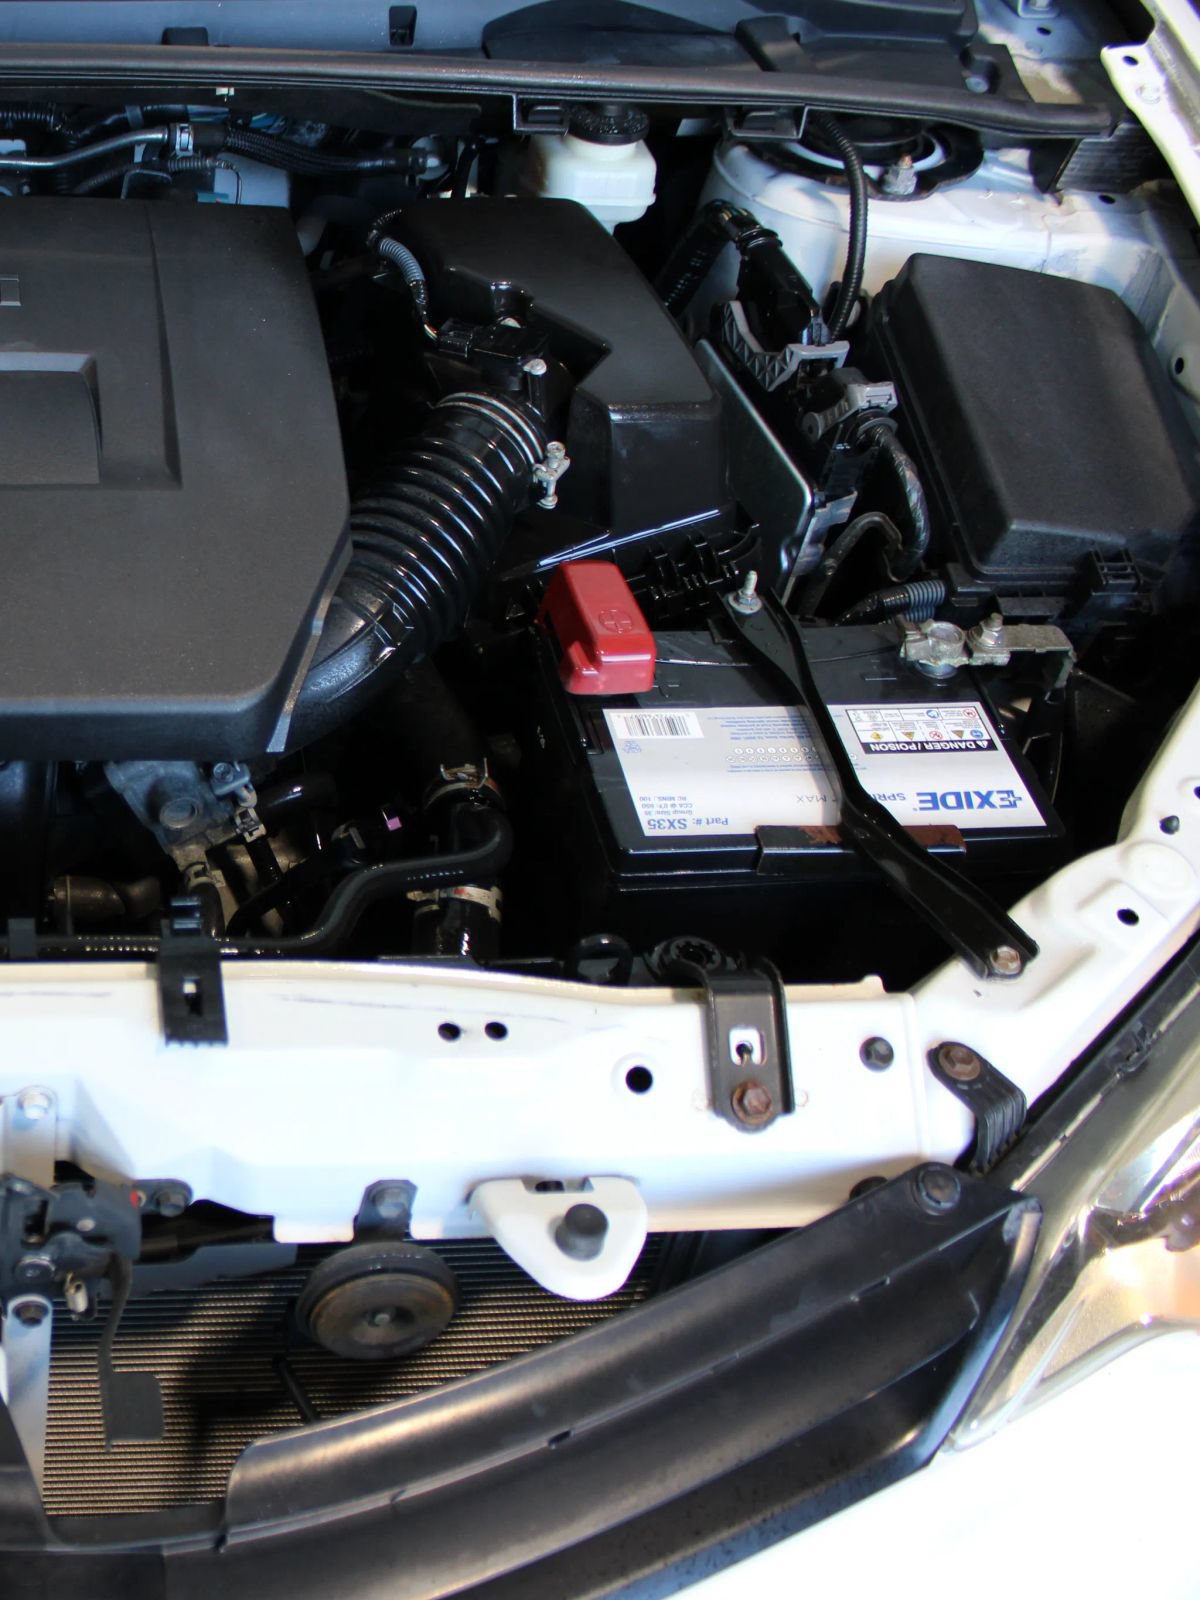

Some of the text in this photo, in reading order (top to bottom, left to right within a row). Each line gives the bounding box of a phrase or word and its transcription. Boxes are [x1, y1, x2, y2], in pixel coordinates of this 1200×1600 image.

[869, 743, 916, 752] POISON
[923, 742, 977, 750] DANGER
[796, 795, 827, 804] MAX
[915, 790, 1023, 812] EXIDE
[647, 818, 688, 830] SX35
[706, 817, 729, 826] Part
